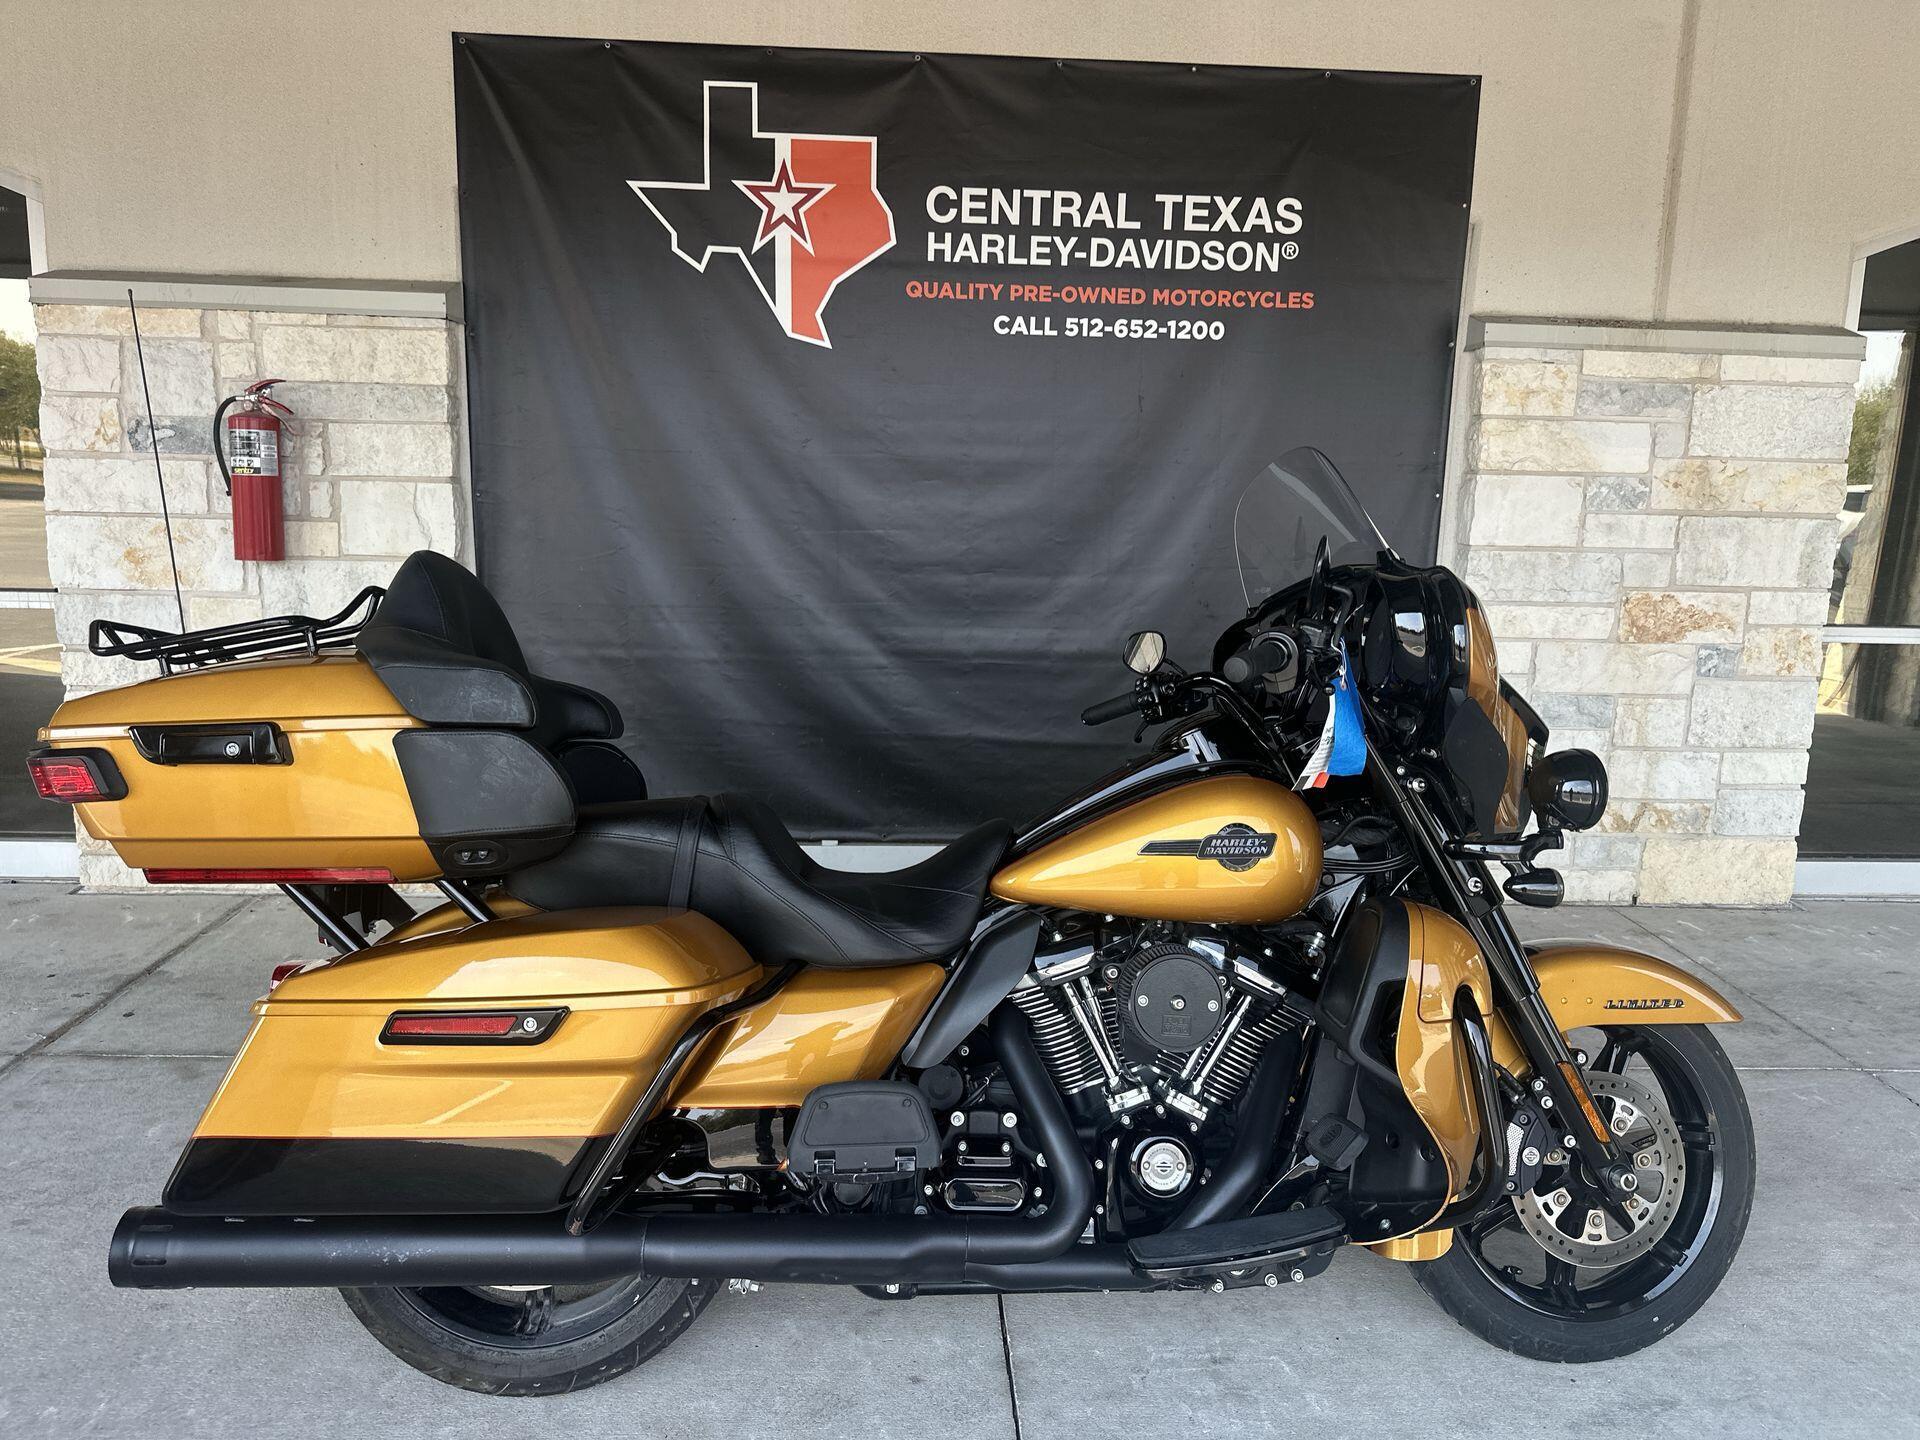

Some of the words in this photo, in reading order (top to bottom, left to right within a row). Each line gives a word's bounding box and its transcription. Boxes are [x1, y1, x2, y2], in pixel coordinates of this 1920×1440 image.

[925, 185, 1142, 230] CENTRAL
[1154, 193, 1303, 235] TEXAS
[905, 280, 1004, 301] QUALITY
[1009, 283, 1147, 305] PRE-OWNED
[1152, 288, 1315, 310] MOTORCYCLES
[993, 314, 1058, 337] CALL
[1064, 316, 1226, 341] 512-652-1200
[1204, 846, 1268, 855] DAVIDSON
[1210, 838, 1267, 846] HARLEY-
[1604, 998, 1685, 1009] LIMITED
